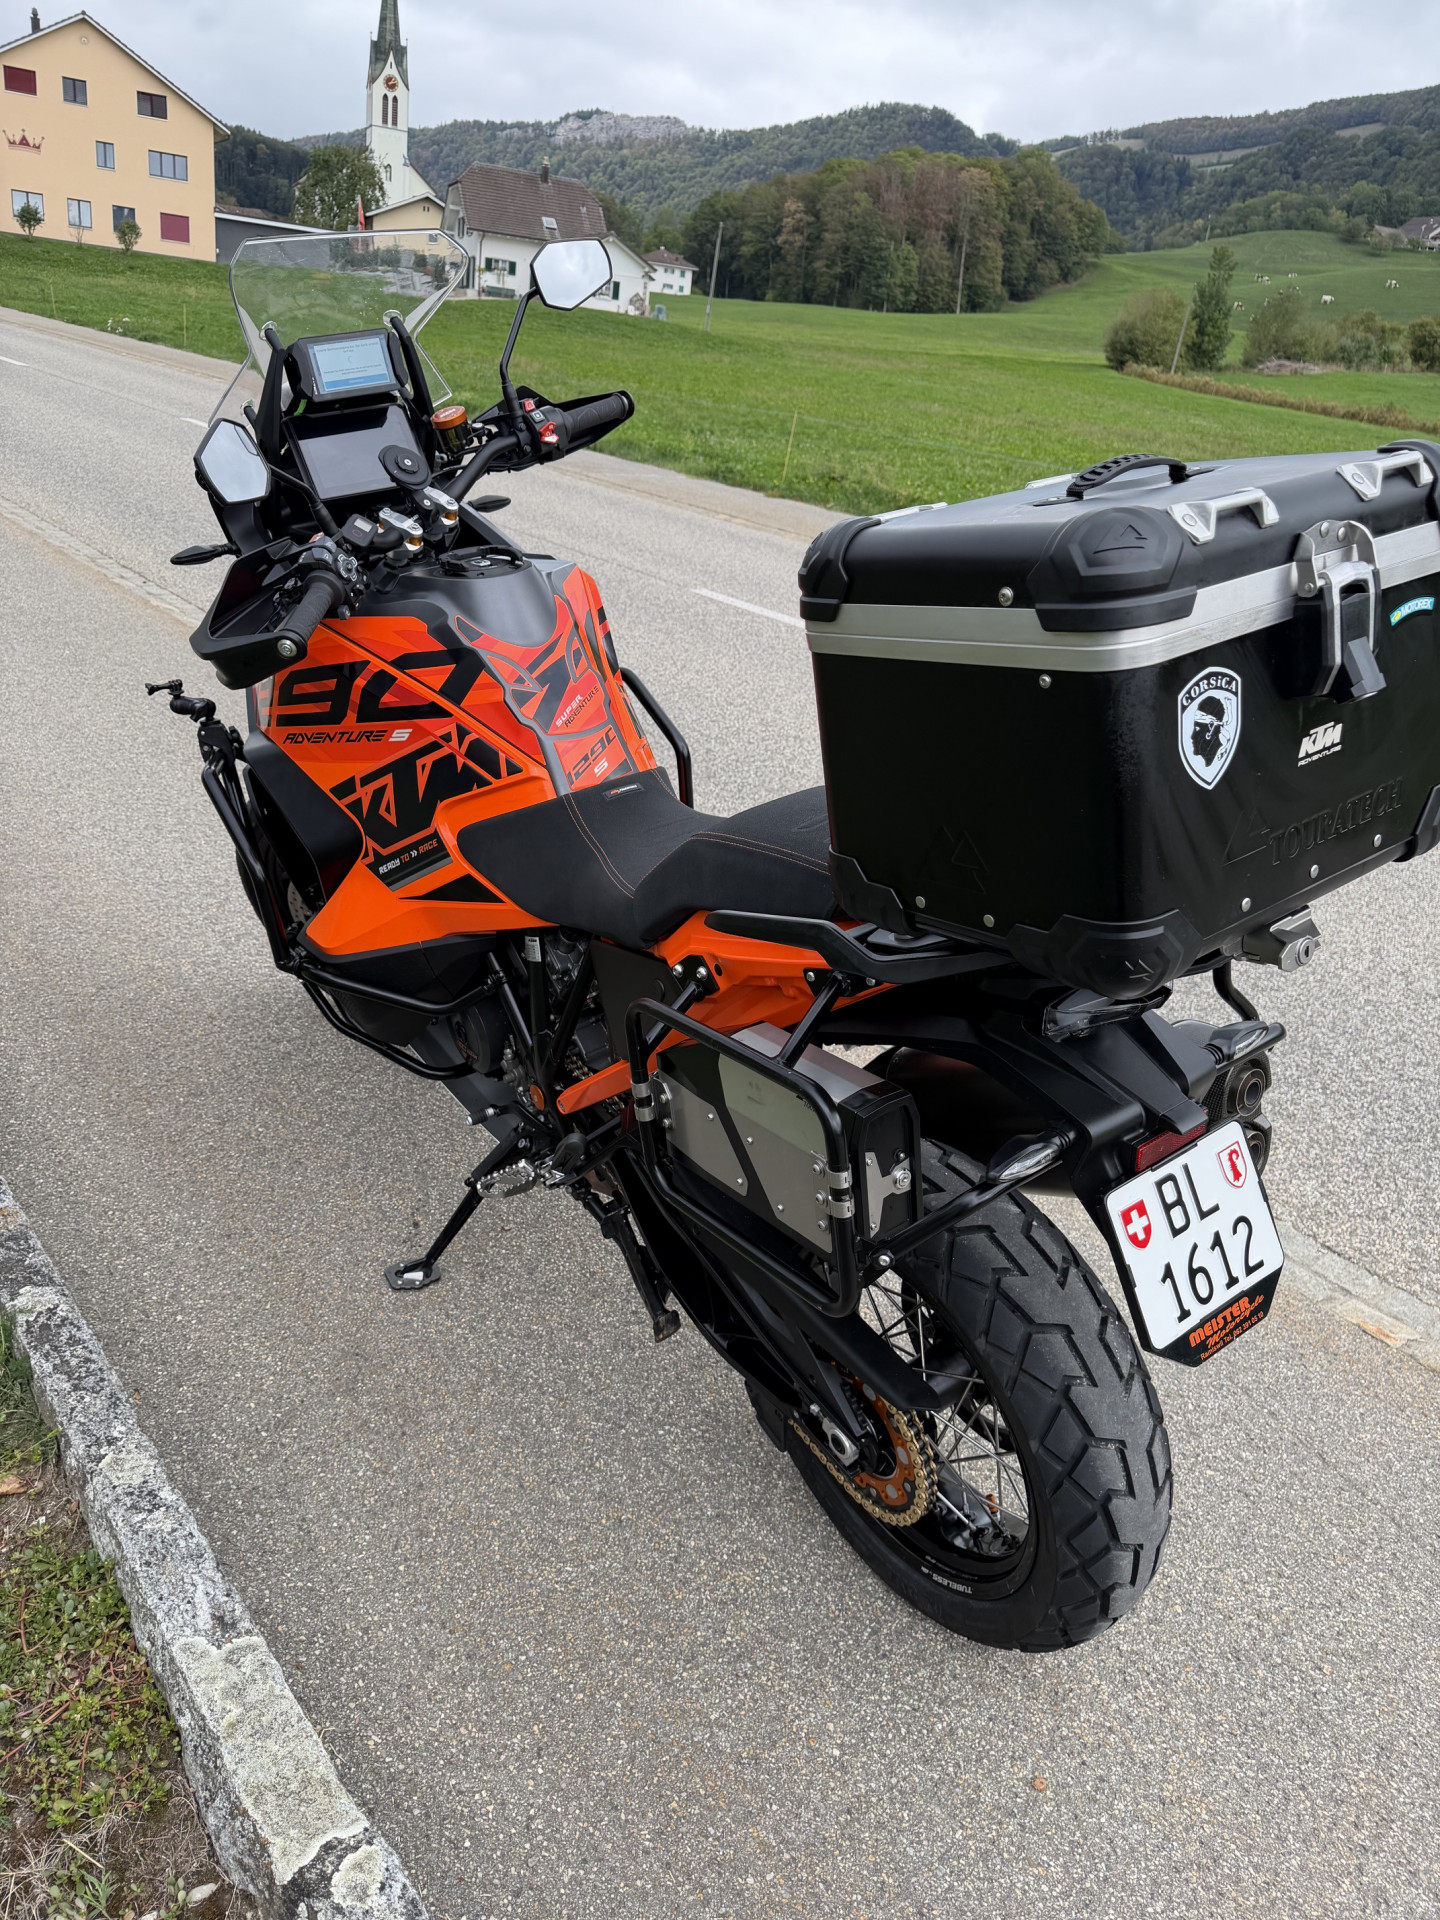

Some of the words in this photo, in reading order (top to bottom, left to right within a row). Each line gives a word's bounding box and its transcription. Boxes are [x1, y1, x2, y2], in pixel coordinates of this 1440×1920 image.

[1400, 599, 1431, 617] MOTOREX
[555, 694, 583, 727] SUPER
[565, 686, 600, 728] ADVENTURE
[283, 730, 388, 744] ADVENTURE
[388, 728, 413, 742] S
[1298, 721, 1342, 758] KTM
[594, 758, 609, 778] S
[1298, 745, 1342, 767] ADVENTURE
[1268, 778, 1402, 866] TOURATECH
[378, 857, 400, 875] READY
[400, 853, 410, 863] TO
[418, 838, 438, 854] RACE
[1155, 1163, 1220, 1239] BL
[1161, 1215, 1264, 1323] 1612
[1189, 1297, 1250, 1347] MEISTER
[932, 1573, 972, 1594] TUBELESS
